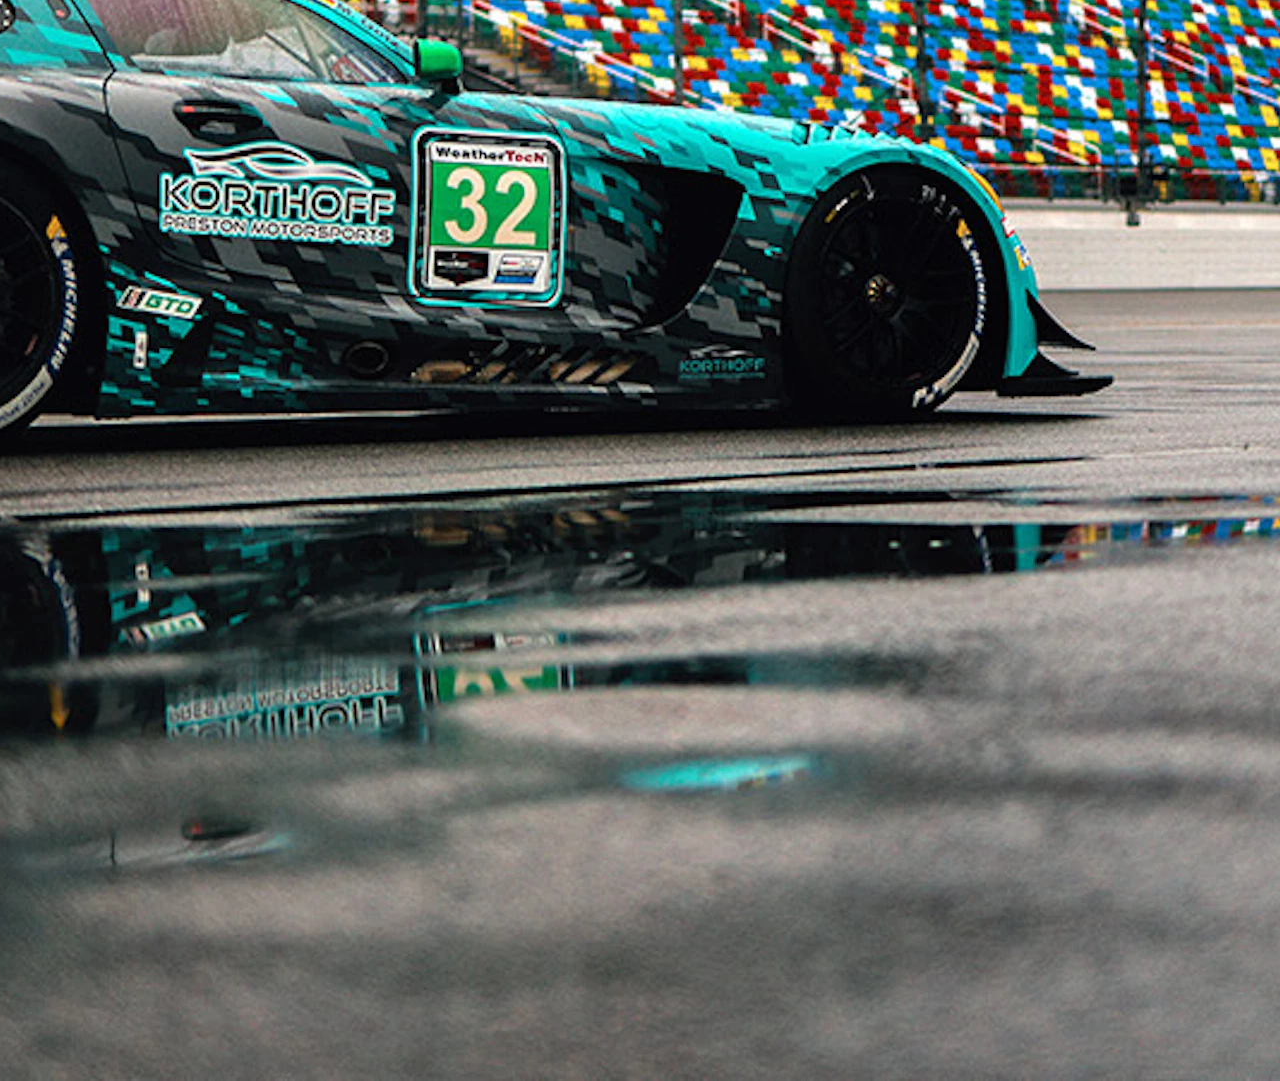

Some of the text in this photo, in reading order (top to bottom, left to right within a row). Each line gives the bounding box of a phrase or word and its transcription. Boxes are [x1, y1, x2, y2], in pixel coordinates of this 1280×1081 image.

[160, 172, 396, 224] KORTHOFF
[444, 166, 538, 246] 32
[161, 213, 395, 246] PRESTON MOTORSPORTS
[144, 293, 195, 315] GTD
